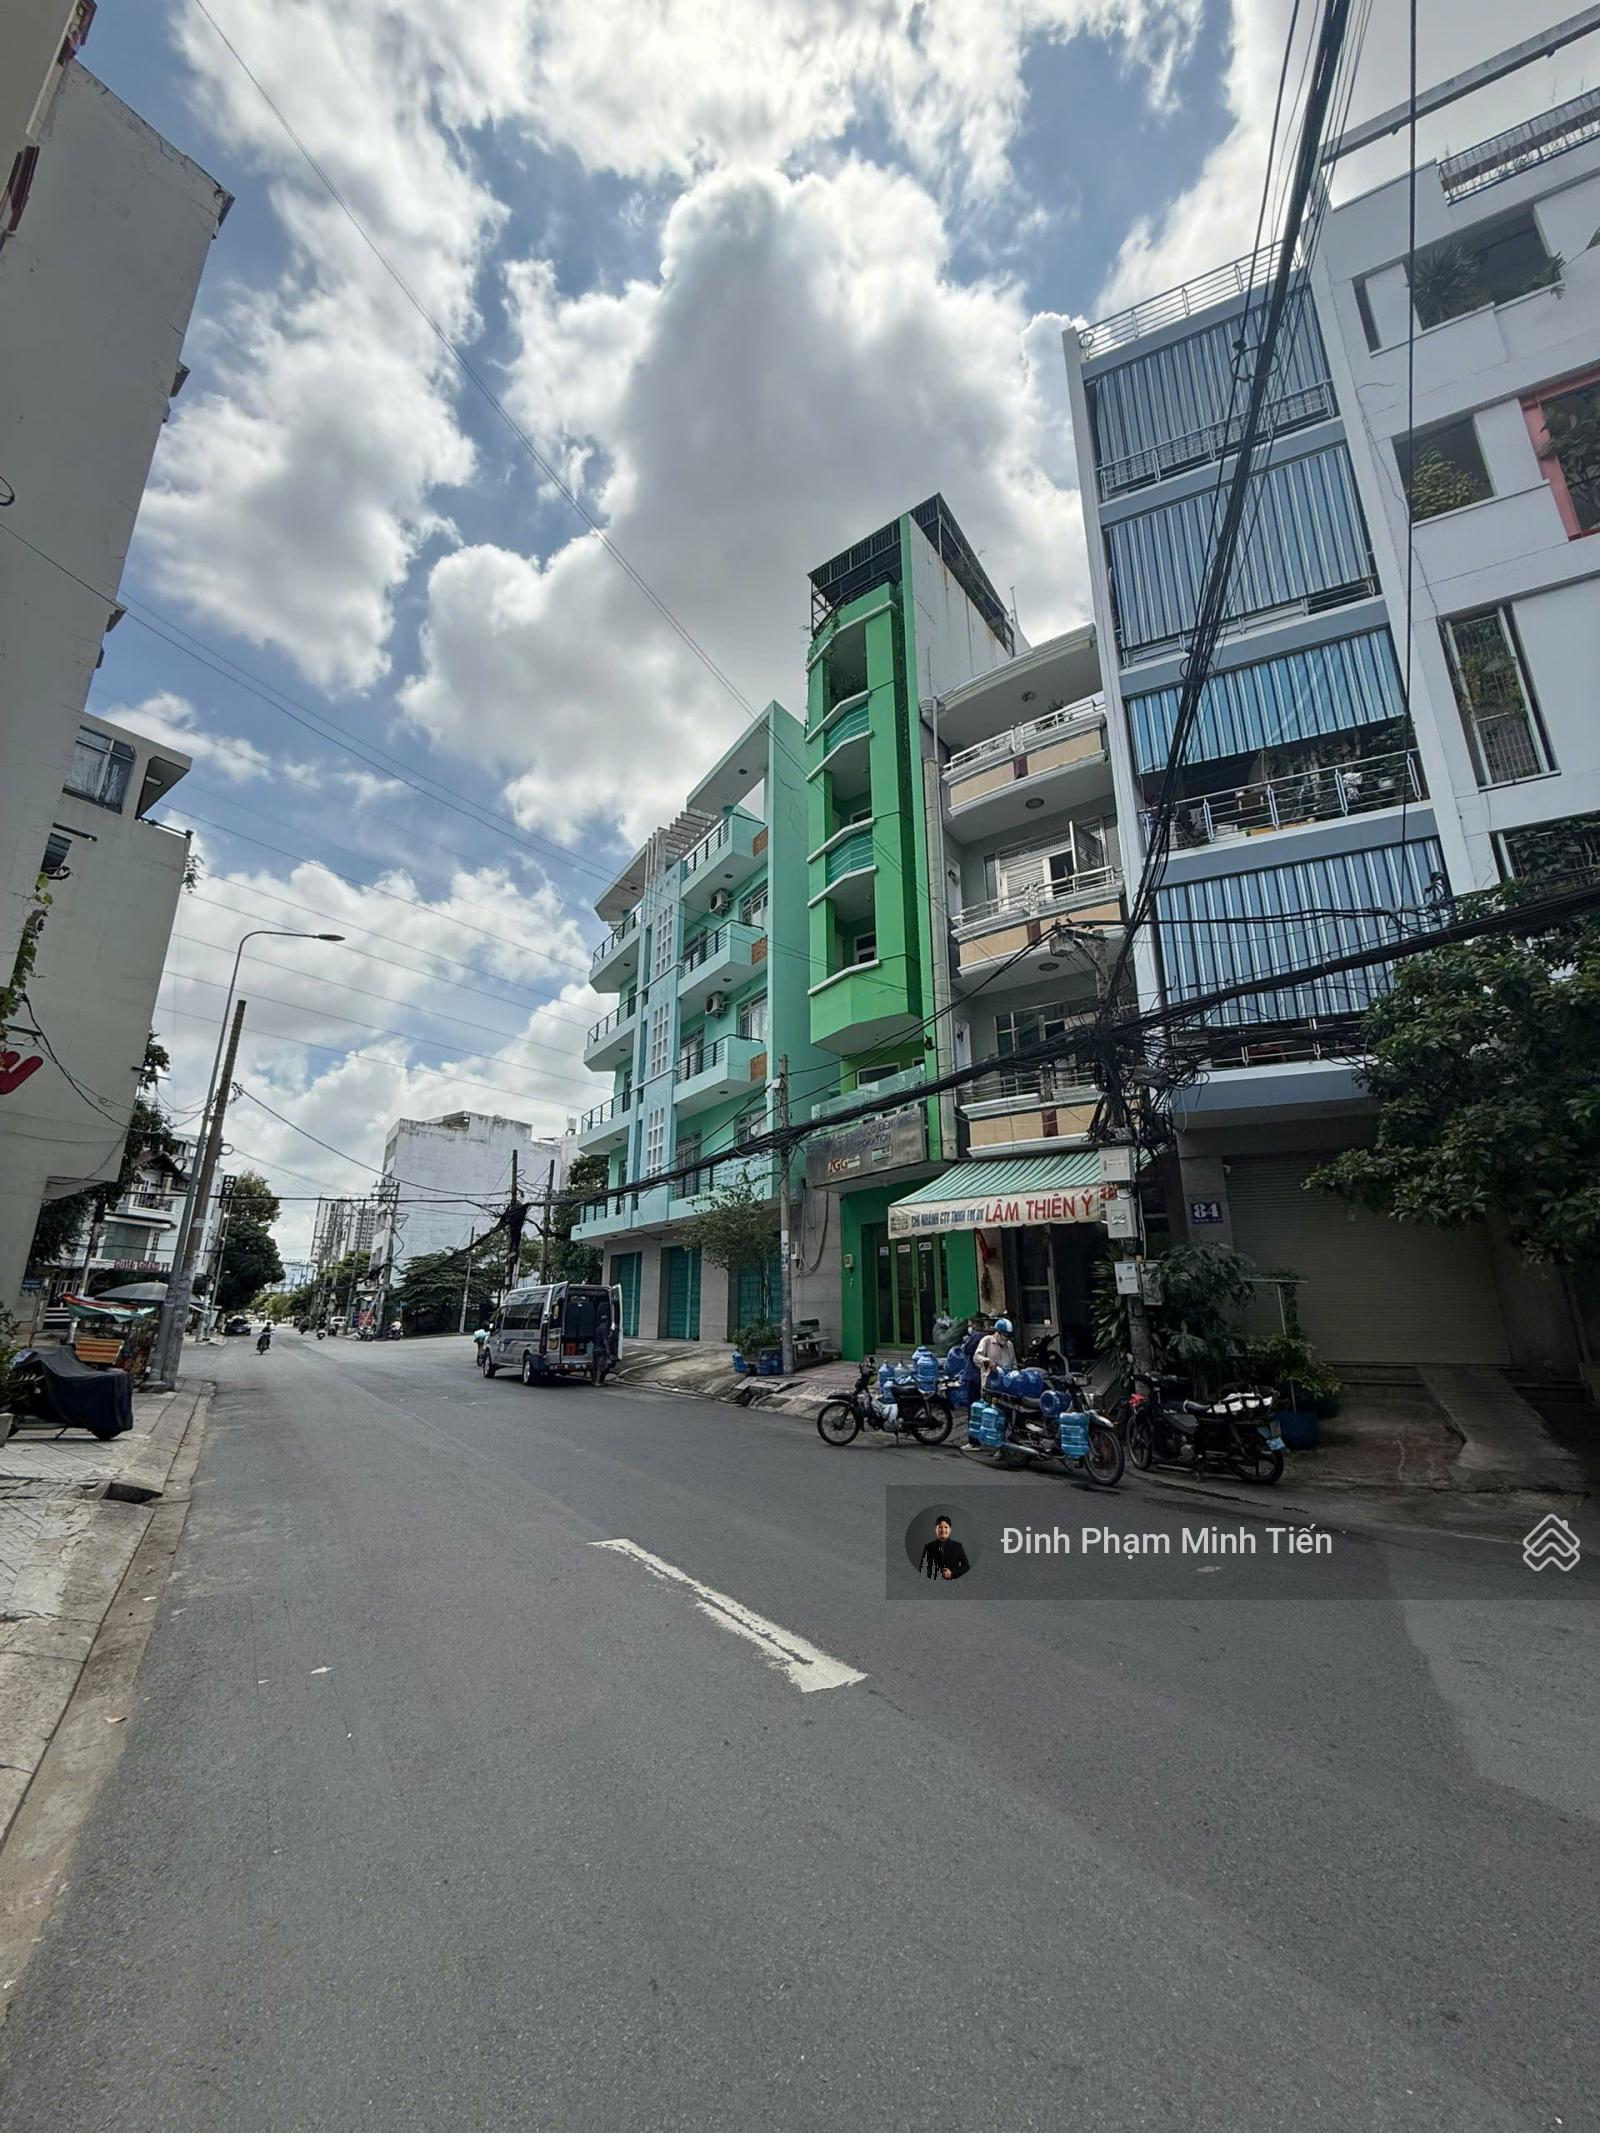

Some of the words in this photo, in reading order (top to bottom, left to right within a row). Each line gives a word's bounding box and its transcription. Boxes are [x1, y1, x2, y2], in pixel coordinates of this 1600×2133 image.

[940, 1210, 951, 1224] CTY
[985, 1199, 1019, 1223] LÂM
[1026, 1193, 1076, 1220] THIÊN
[1081, 1189, 1093, 1217] Ý
[1193, 1203, 1219, 1218] 84
